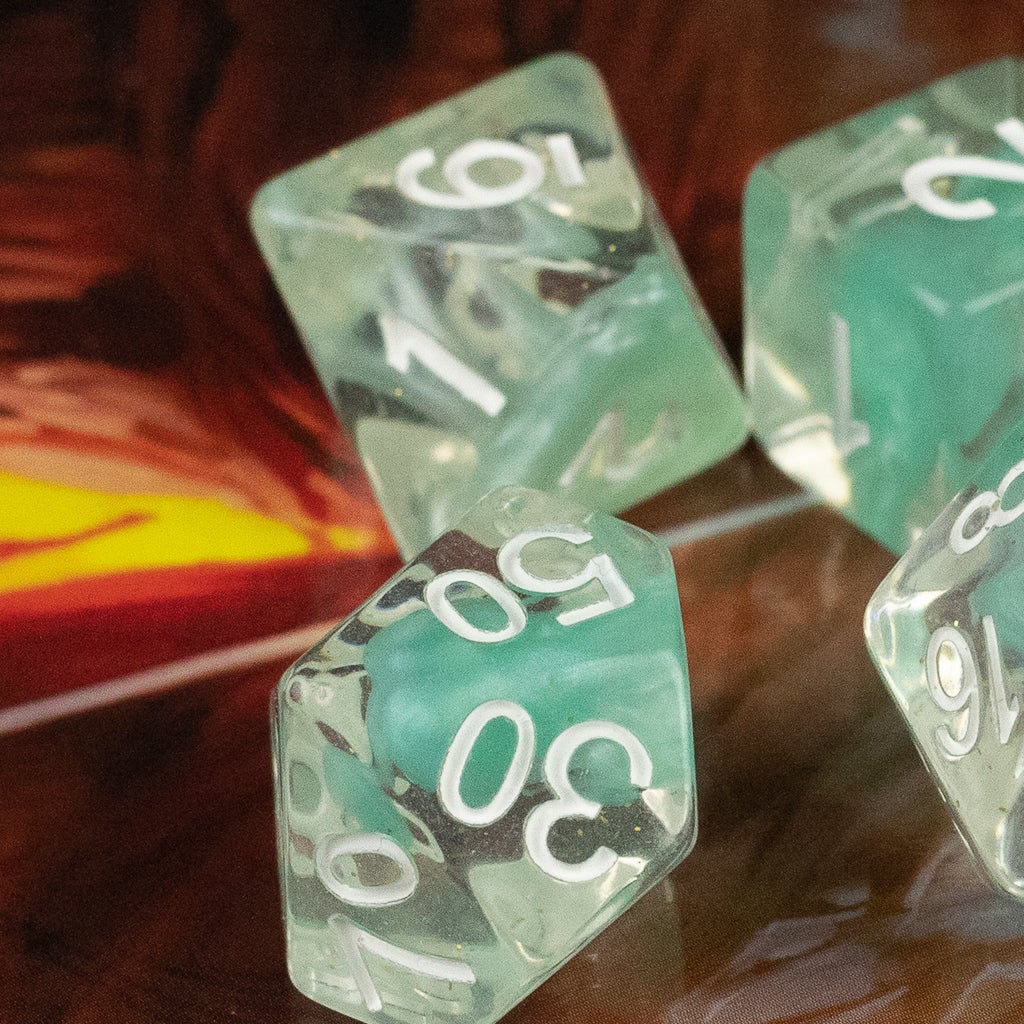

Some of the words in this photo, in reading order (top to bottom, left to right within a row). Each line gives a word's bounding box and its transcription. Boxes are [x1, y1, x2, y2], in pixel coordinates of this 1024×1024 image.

[379, 312, 506, 417] 1
[425, 525, 636, 644] 50
[438, 700, 654, 884] 30
[315, 832, 476, 1013] 70
